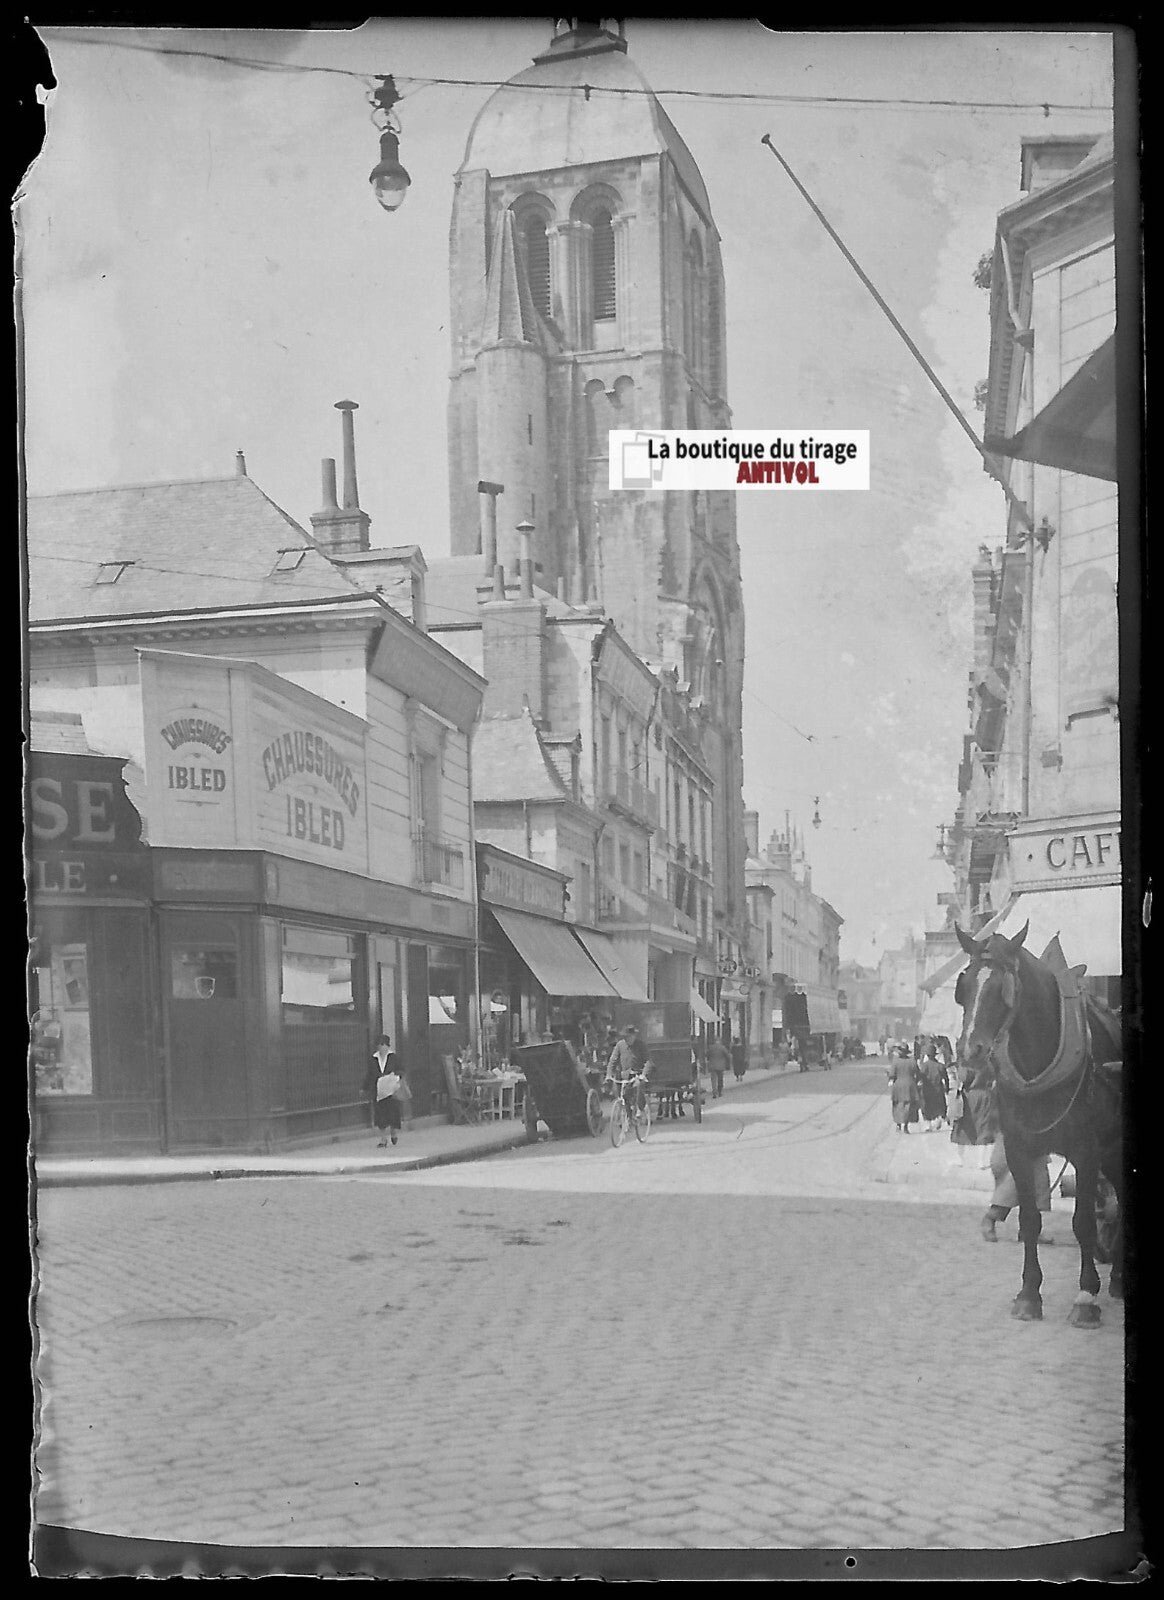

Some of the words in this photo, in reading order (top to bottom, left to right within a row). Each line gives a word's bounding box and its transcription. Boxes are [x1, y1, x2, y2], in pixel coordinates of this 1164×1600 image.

[160, 718, 232, 755] CHAUSSURES
[168, 765, 226, 792] IBLED
[261, 731, 360, 818] CHAUSSURES
[286, 793, 345, 851] IBLED
[1046, 832, 1121, 869] CAF
